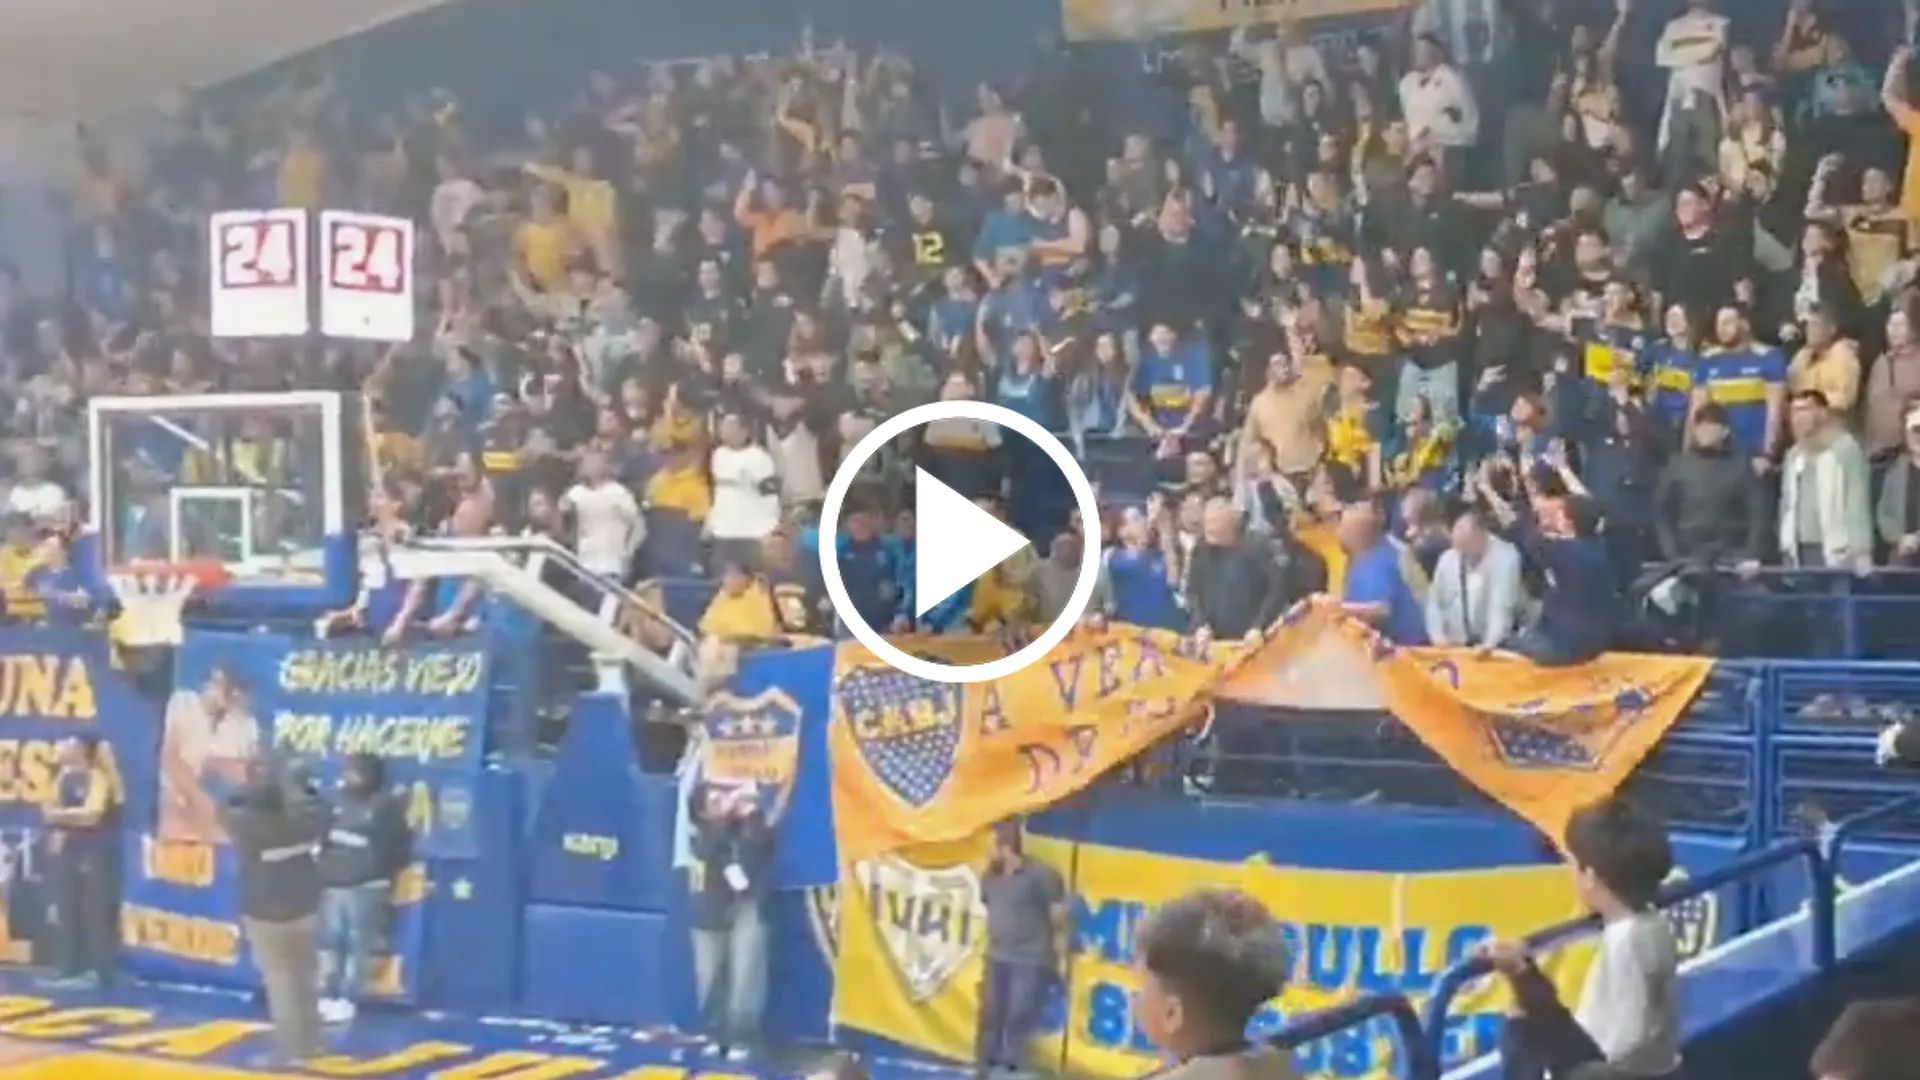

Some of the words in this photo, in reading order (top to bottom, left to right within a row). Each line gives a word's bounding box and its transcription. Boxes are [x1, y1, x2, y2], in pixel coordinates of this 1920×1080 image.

[225, 224, 293, 284] 24
[334, 226, 400, 288] 24
[911, 231, 944, 265] 12
[279, 650, 398, 694] GRACIAS
[273, 709, 332, 758] POR
